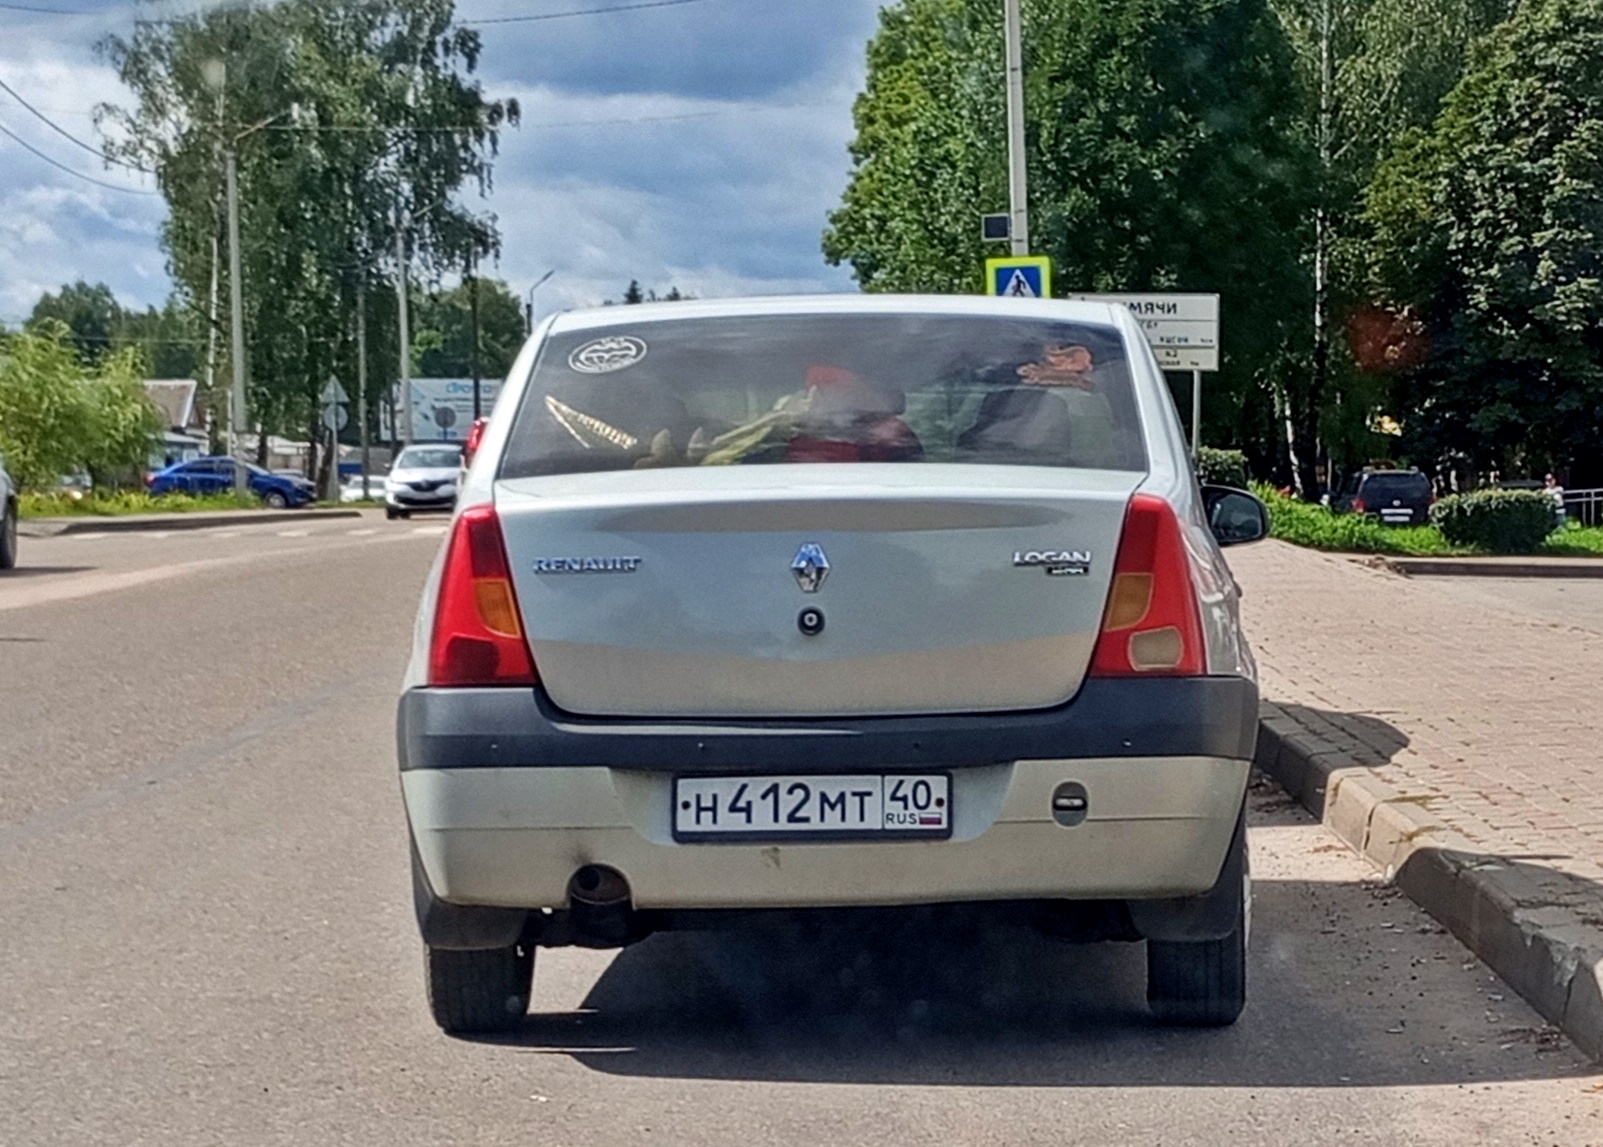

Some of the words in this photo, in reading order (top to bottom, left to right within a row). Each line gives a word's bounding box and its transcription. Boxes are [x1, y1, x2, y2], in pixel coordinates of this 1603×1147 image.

[1124, 302, 1177, 314] МЯЧИ
[533, 557, 641, 573] RENAULT
[1013, 551, 1091, 566] LOGAN
[889, 779, 932, 811] 40
[885, 812, 917, 825] RUS
